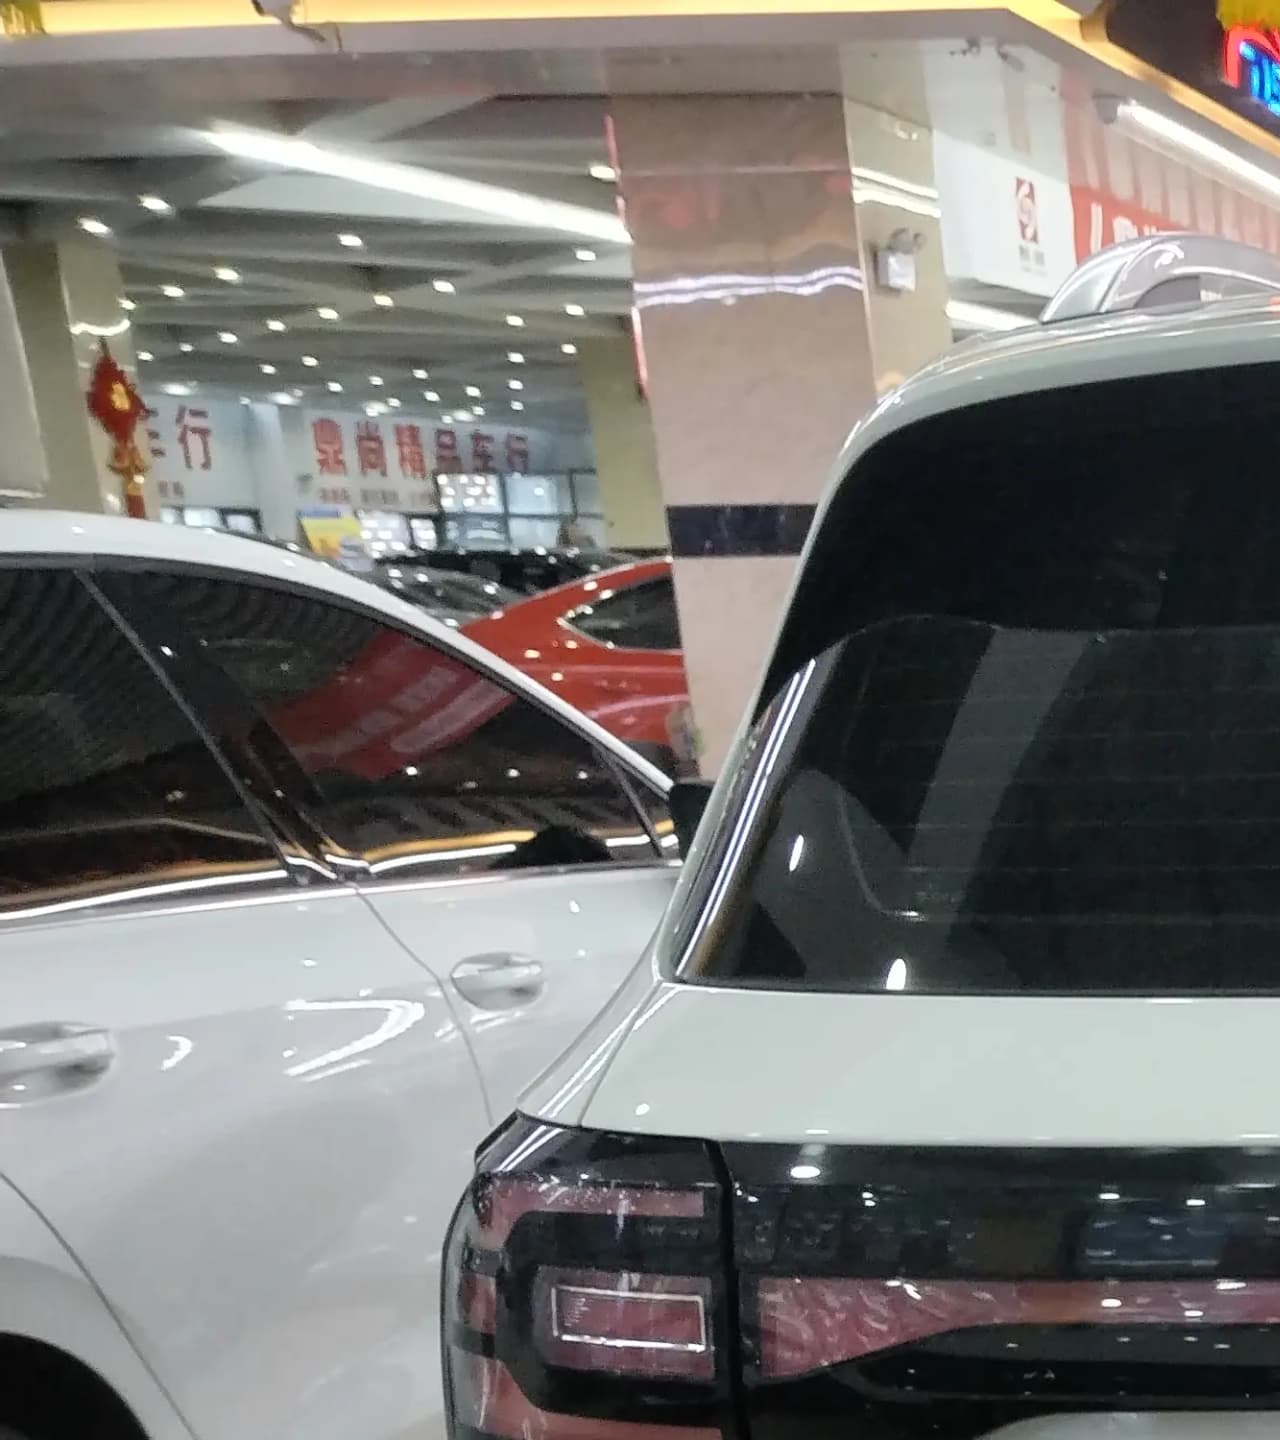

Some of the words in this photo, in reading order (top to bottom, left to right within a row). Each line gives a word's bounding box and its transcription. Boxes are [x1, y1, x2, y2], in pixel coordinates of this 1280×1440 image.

[311, 417, 530, 478] 鼎尚精品车行
